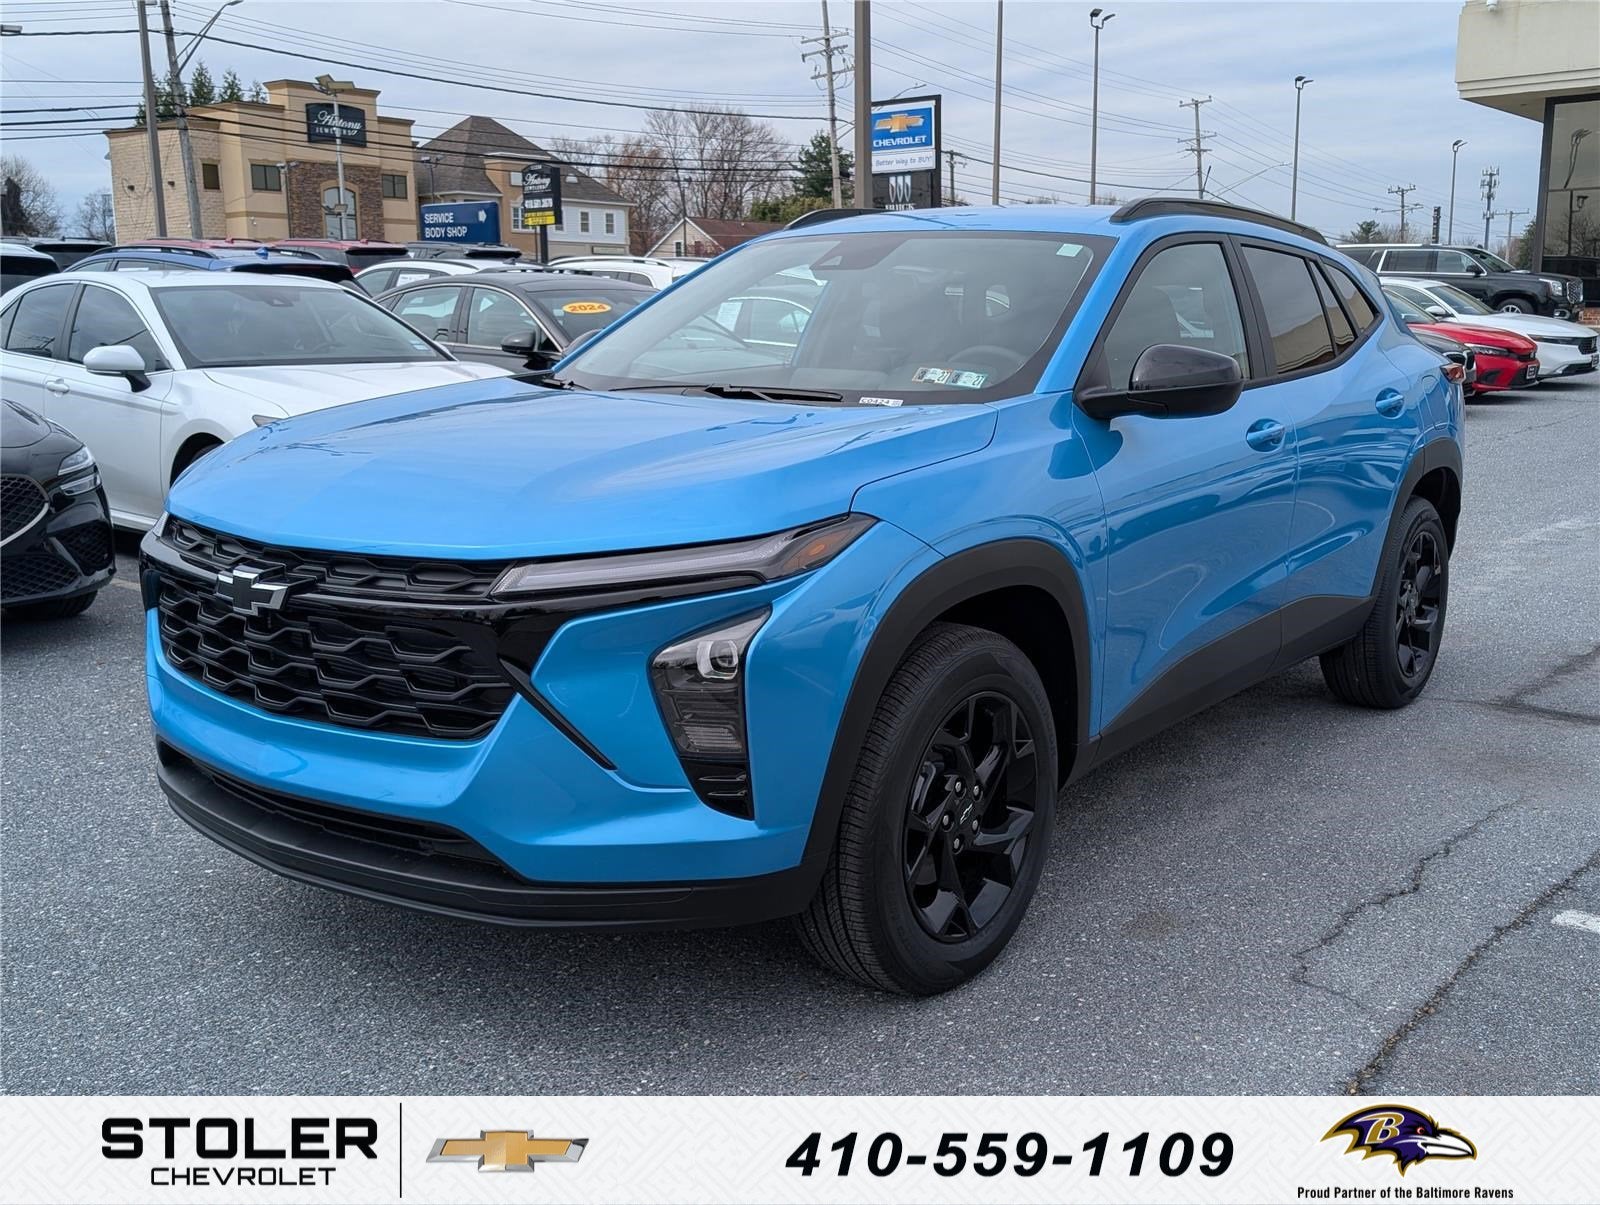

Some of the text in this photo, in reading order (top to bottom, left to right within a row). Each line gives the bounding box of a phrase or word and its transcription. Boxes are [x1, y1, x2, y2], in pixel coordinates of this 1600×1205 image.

[873, 135, 927, 148] CHEVROLET
[875, 159, 894, 167] Better
[896, 158, 909, 166] Way
[424, 212, 454, 224] SERVICE
[425, 225, 468, 239] BODY SHOP
[568, 304, 607, 312] 2024
